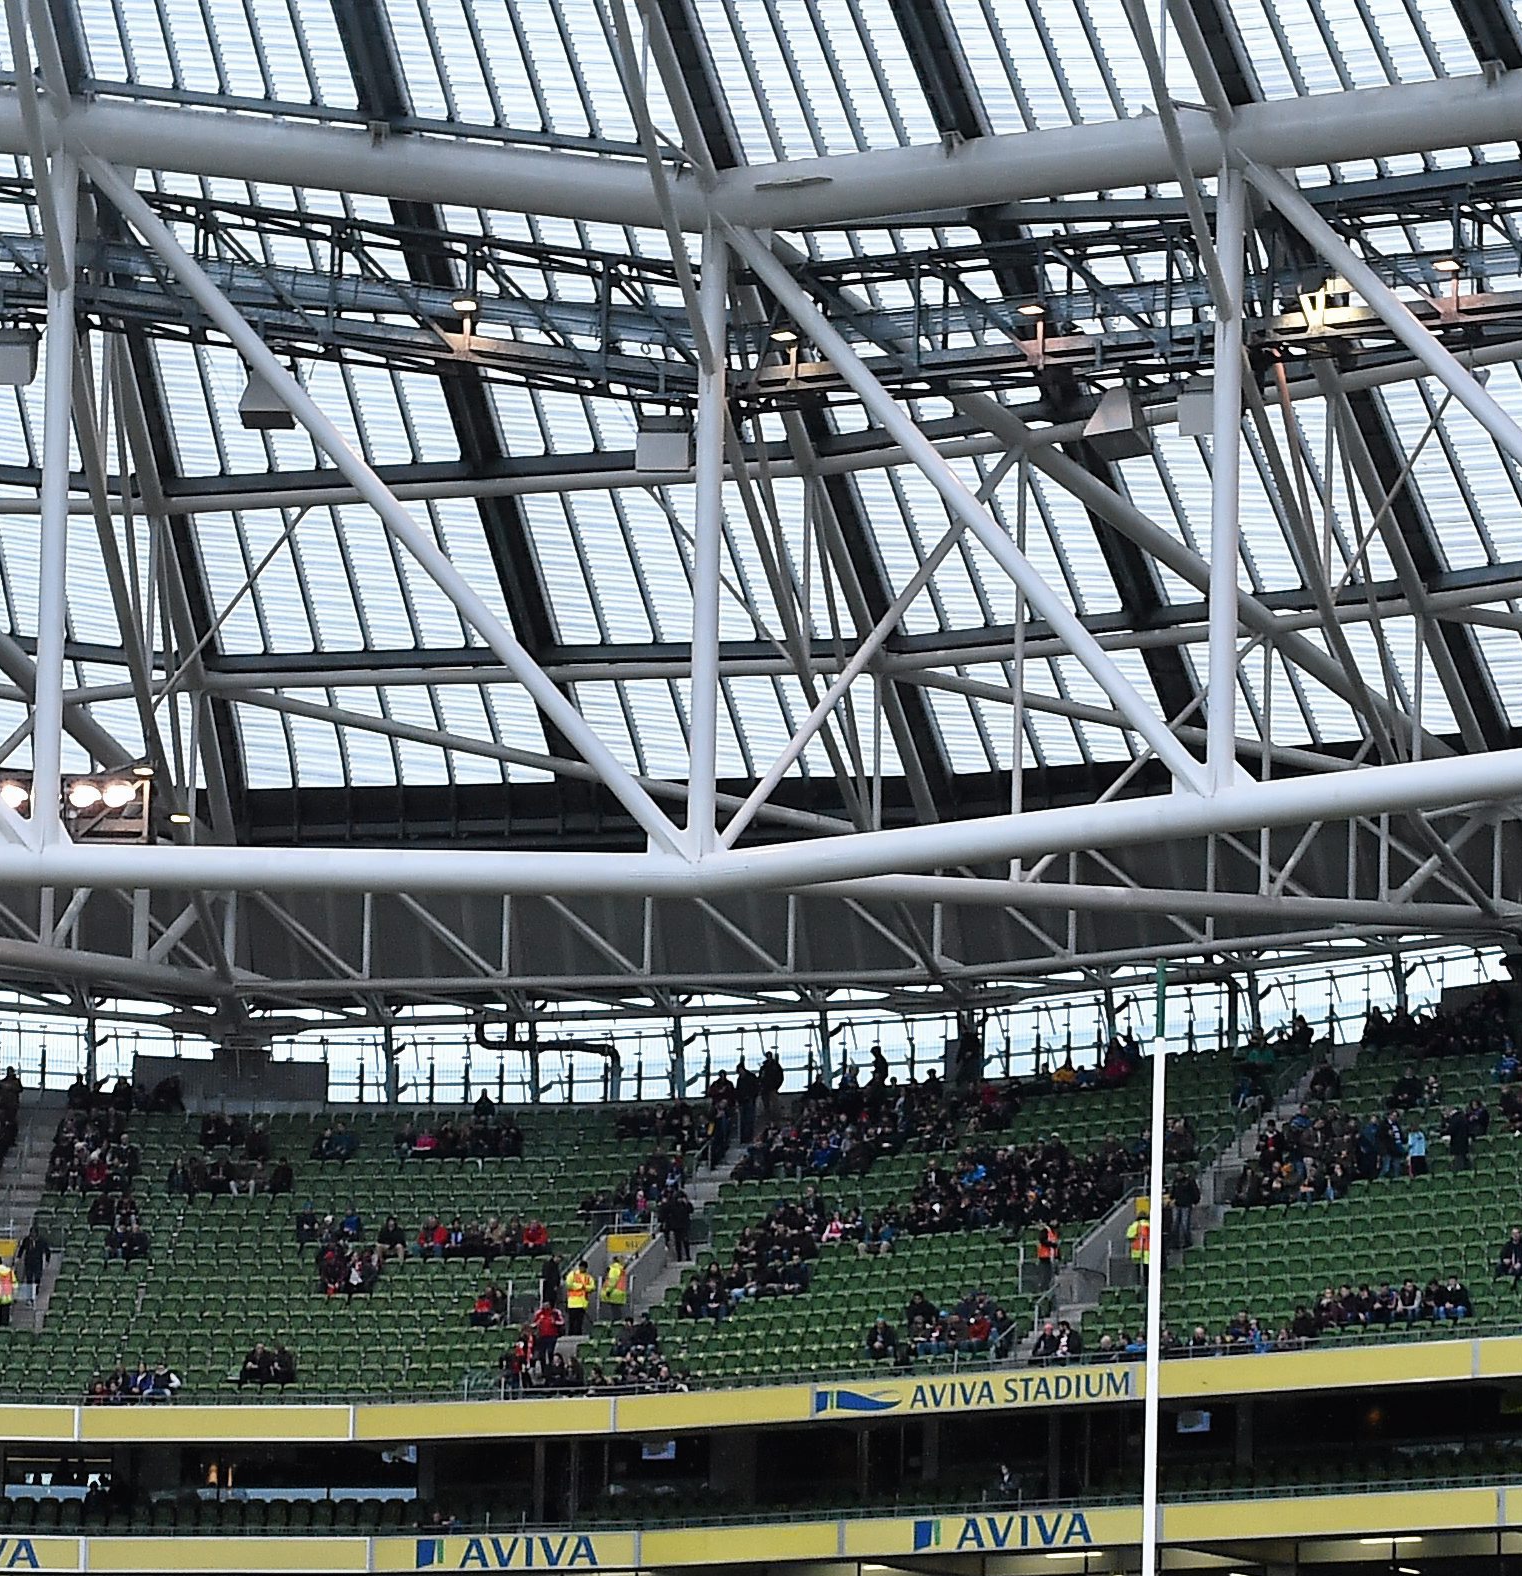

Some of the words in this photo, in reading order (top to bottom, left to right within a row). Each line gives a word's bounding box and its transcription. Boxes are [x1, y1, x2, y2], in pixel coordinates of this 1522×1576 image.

[910, 1378, 995, 1408] AVIVA
[1002, 1371, 1131, 1405] STADIUM
[957, 1511, 1093, 1551] AVIVA
[459, 1535, 598, 1568] AVIVA
